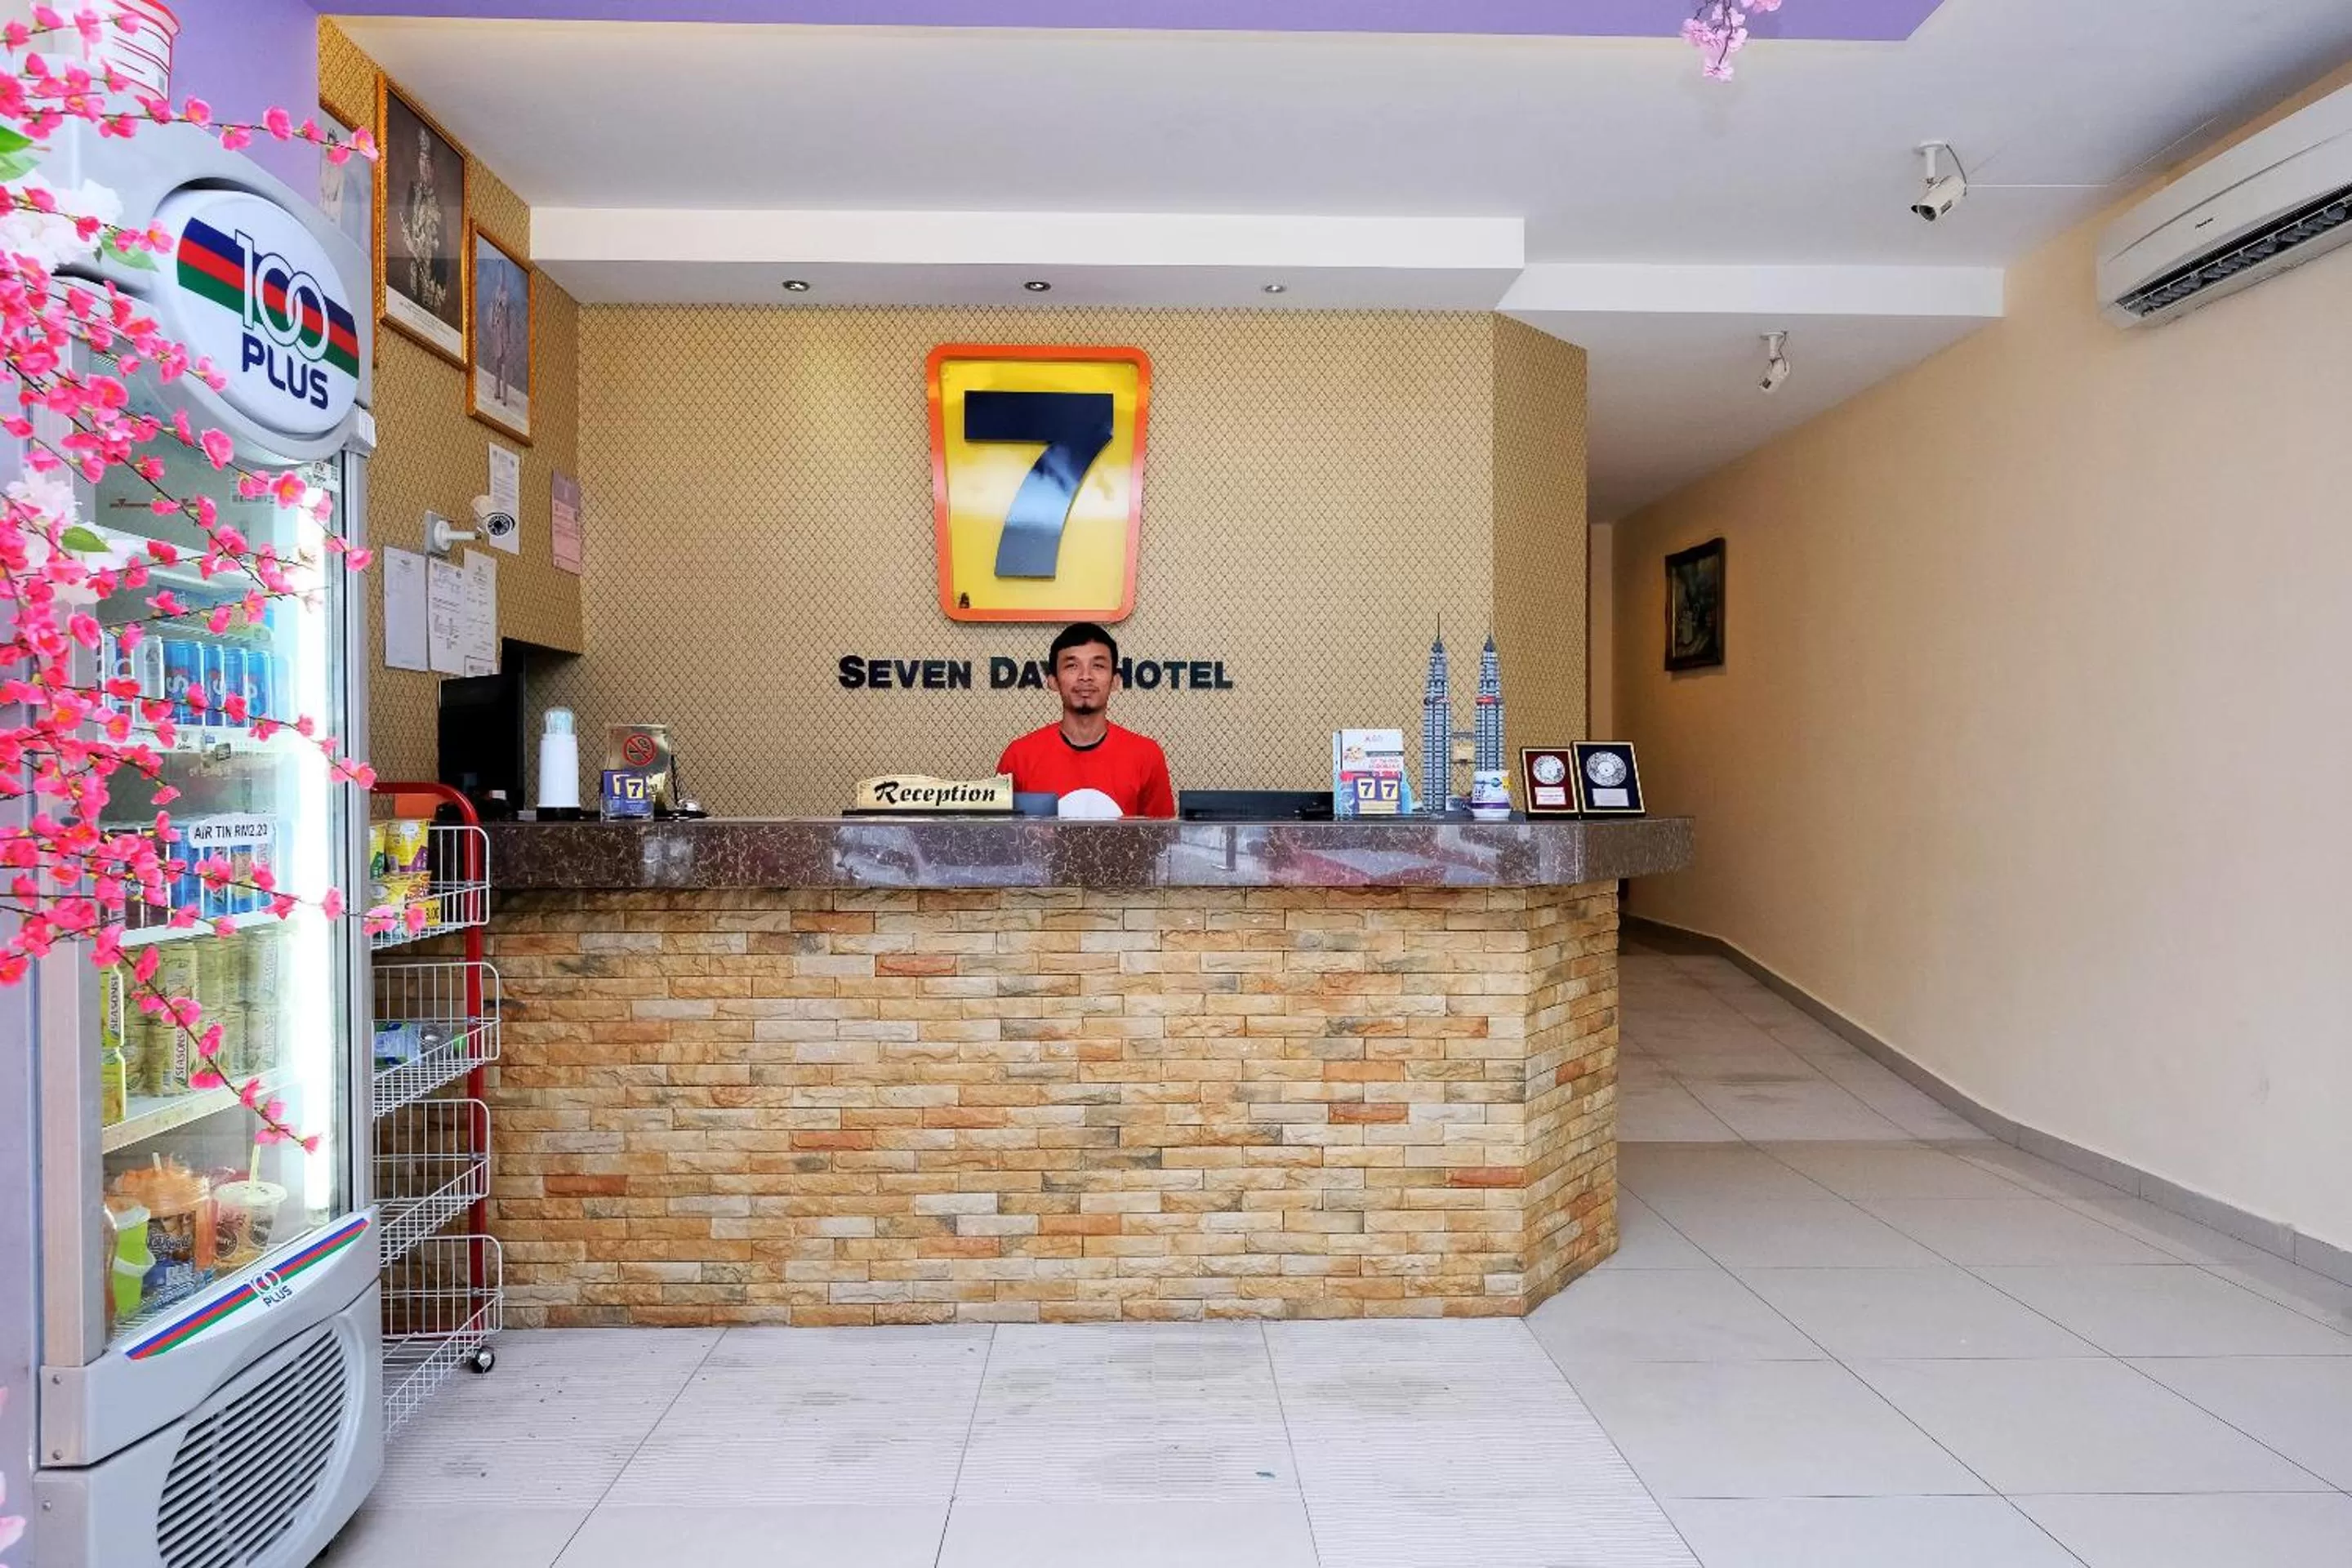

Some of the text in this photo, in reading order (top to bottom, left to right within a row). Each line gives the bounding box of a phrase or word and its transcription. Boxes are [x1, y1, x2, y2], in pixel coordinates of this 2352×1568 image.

[235, 229, 330, 363] 100
[242, 332, 328, 410] PLUS
[964, 390, 1114, 579] 7
[839, 655, 972, 689] SEVEN
[990, 657, 1051, 689] DA
[874, 781, 996, 806] Reception
[1361, 782, 1373, 797] 7
[1383, 783, 1396, 798] 7
[216, 825, 231, 838] TIN
[263, 1285, 292, 1307] PLUS
